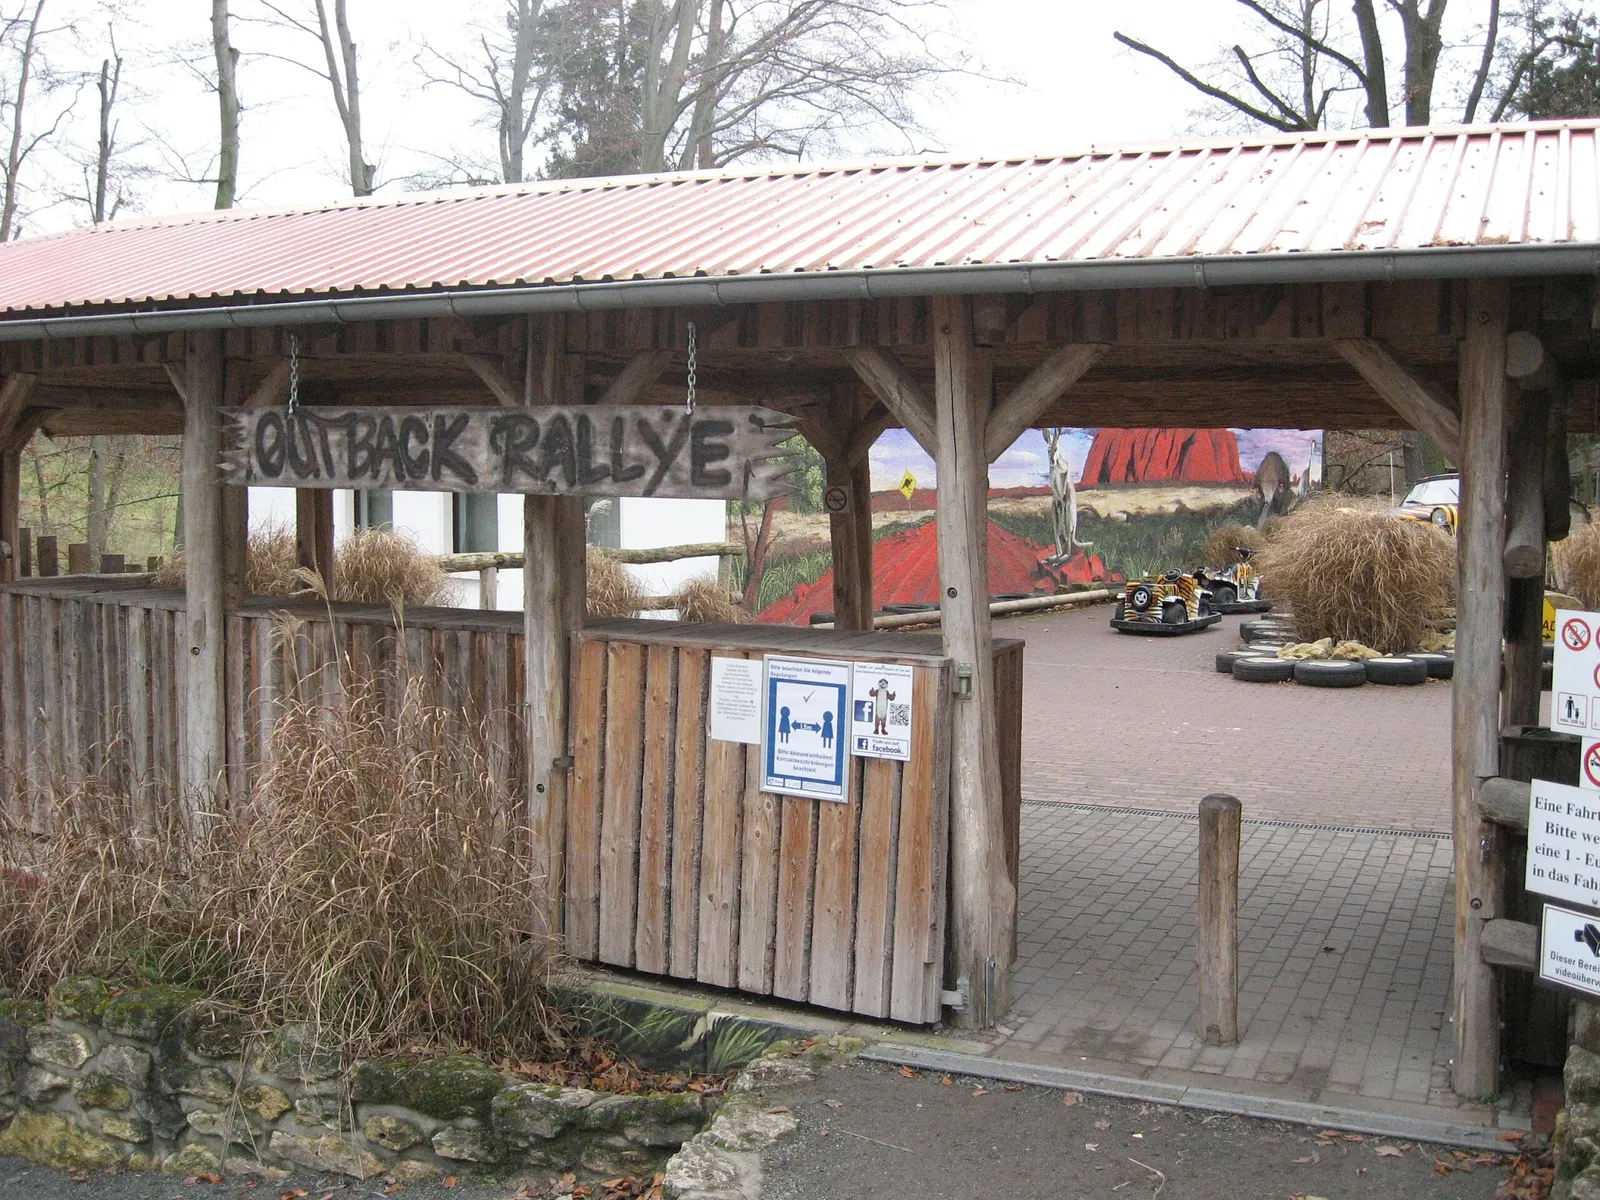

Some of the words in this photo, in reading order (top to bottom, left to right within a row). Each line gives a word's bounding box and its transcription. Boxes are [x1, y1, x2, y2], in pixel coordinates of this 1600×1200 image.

[255, 411, 477, 484] OUTBACK
[491, 411, 734, 496] RALLYE
[776, 755, 834, 768] Kontaktbeschränkungen
[1534, 796, 1562, 814] Eine
[1545, 821, 1577, 840] Bitte
[1535, 844, 1561, 859] eine
[1565, 848, 1571, 861] 1
[1532, 864, 1545, 878] in
[1548, 867, 1570, 884] das
[1550, 950, 1577, 967] Dieser
